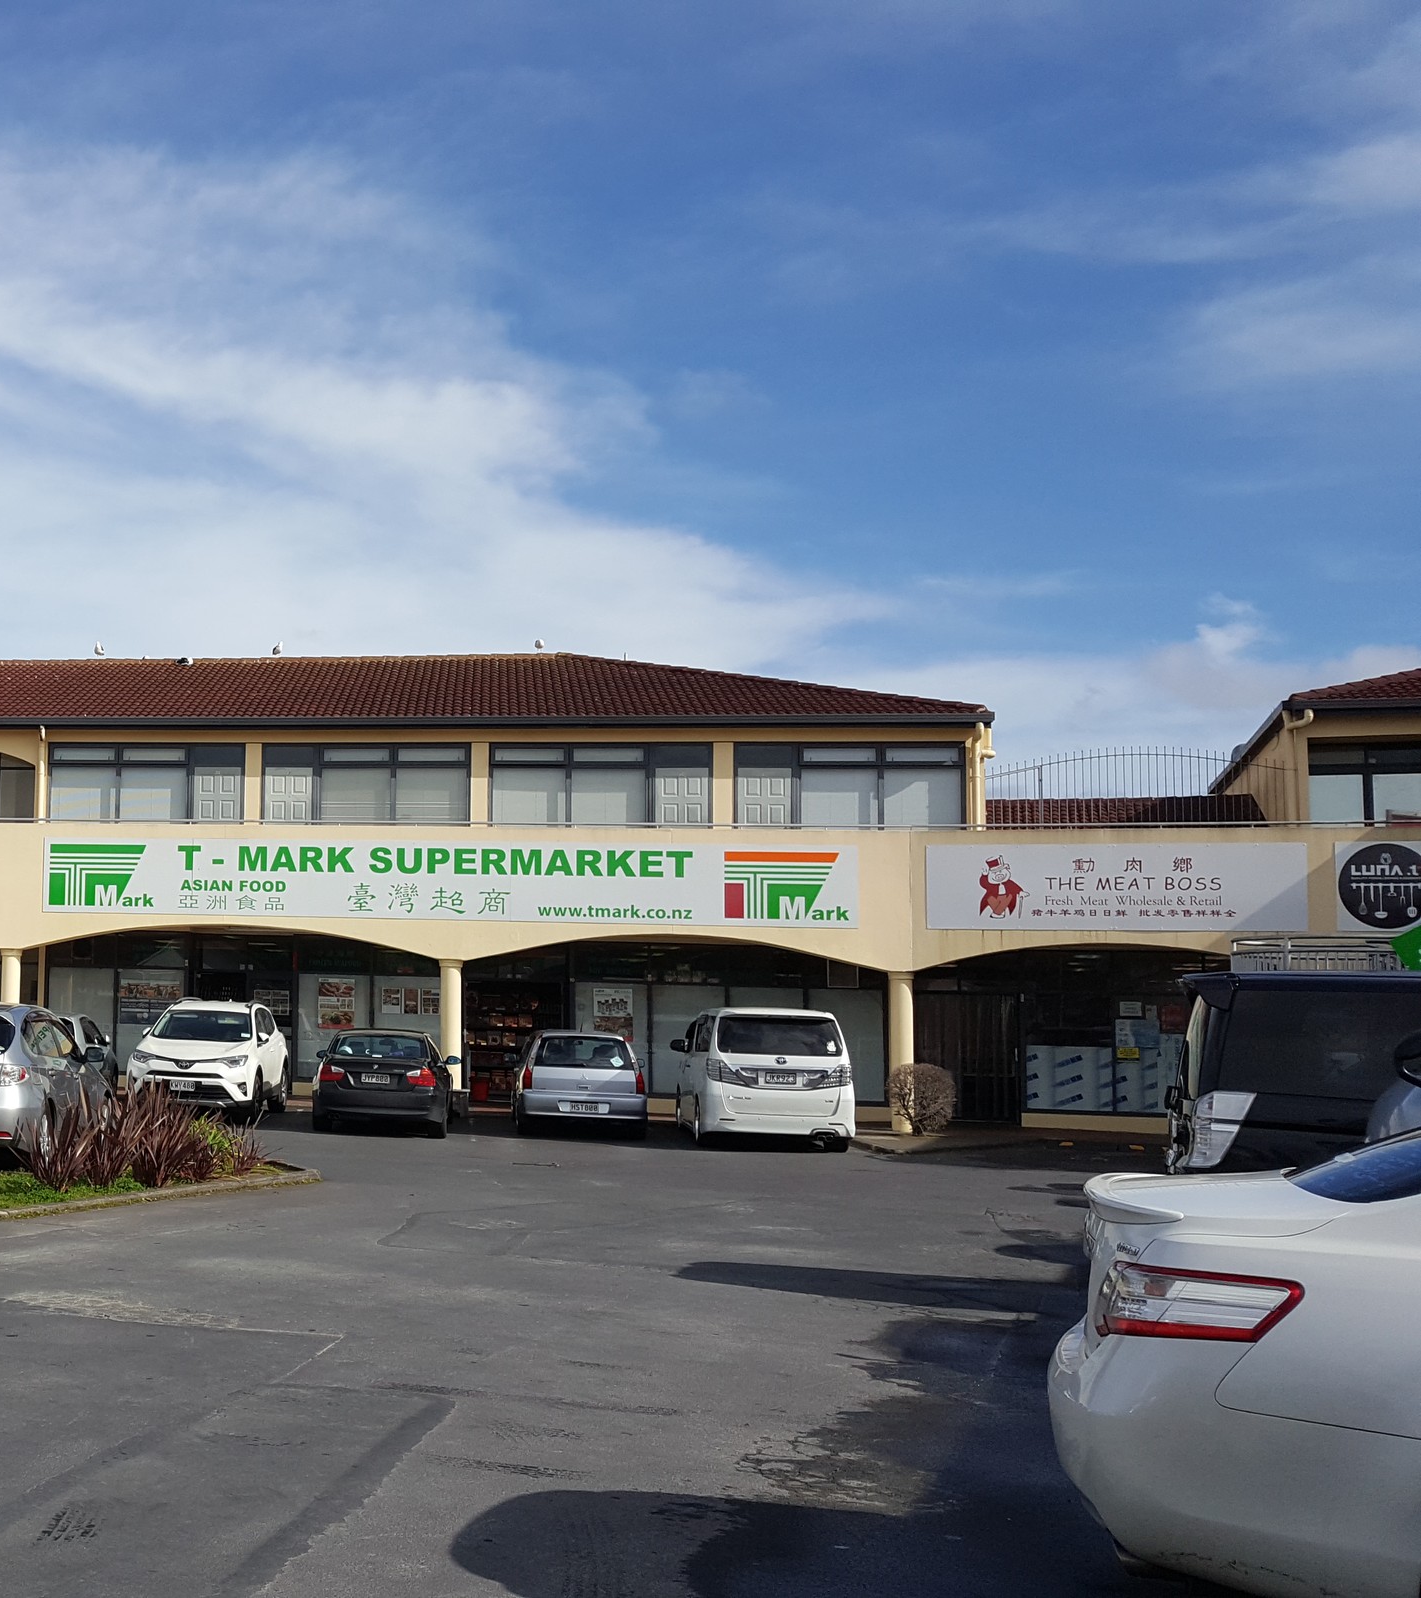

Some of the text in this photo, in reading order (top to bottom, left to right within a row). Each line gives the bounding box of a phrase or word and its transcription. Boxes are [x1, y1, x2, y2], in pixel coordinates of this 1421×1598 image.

[177, 845, 202, 871] T
[237, 845, 355, 874] MARK
[368, 847, 693, 879] SUPERMARKET
[180, 879, 287, 893] ASIAN FOOD
[1044, 876, 1222, 892] THE MEAT BOSS
[177, 894, 285, 911] 亞洲食品
[347, 882, 511, 915] 臺灣超商
[1044, 895, 1222, 906] Fresh Meat Wholesale & Retail
[537, 904, 693, 920] www.tmark.co.nz
